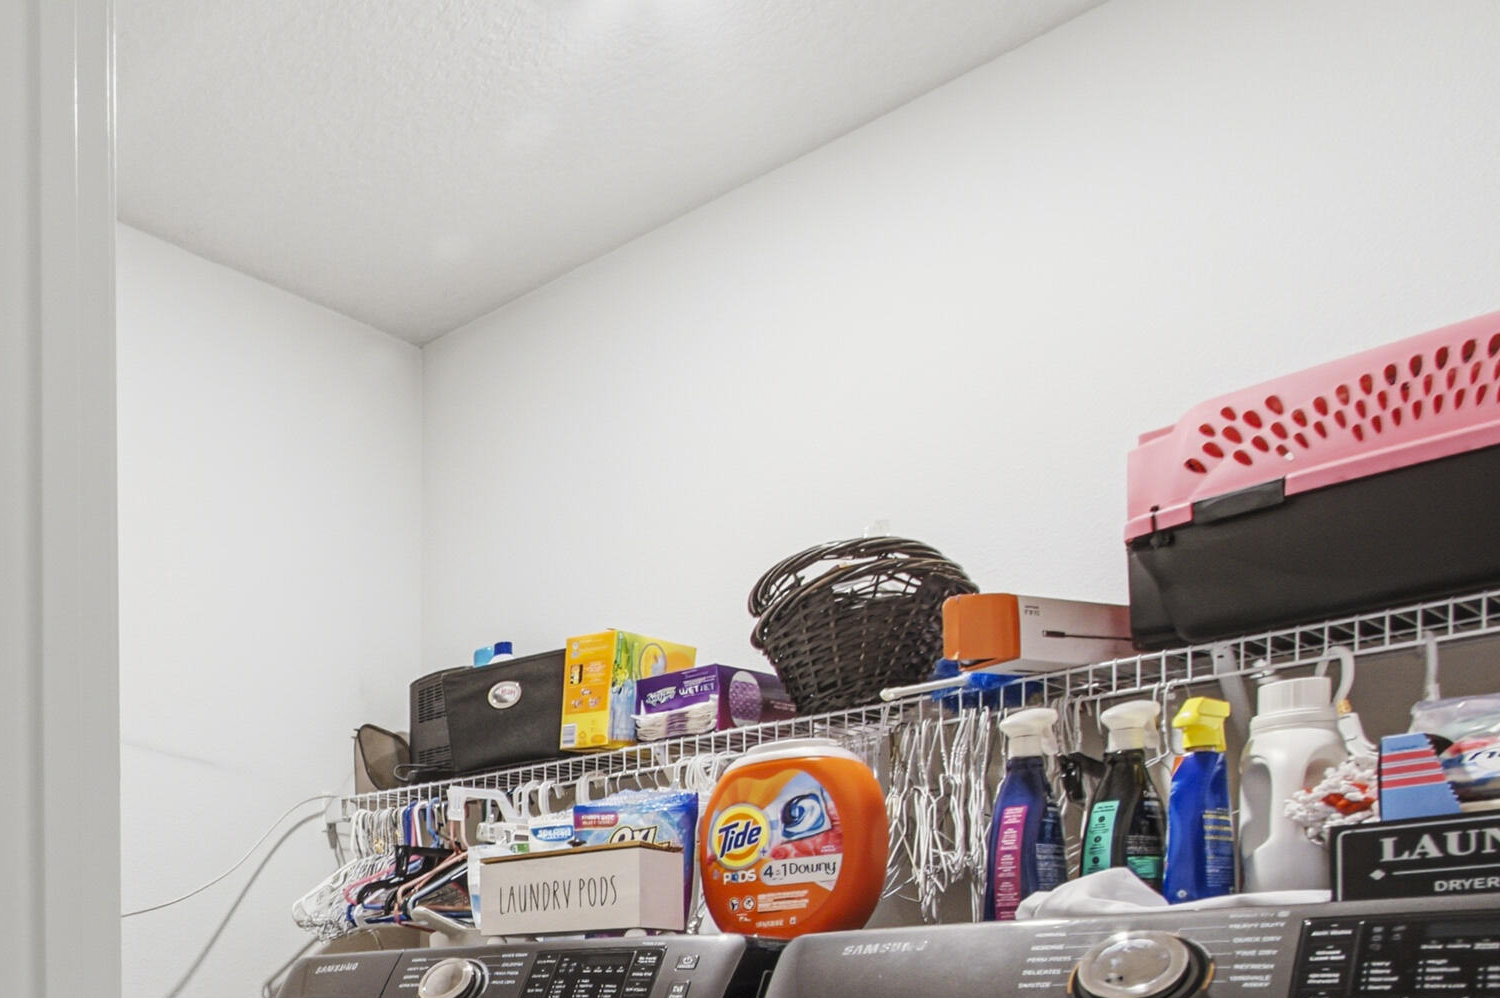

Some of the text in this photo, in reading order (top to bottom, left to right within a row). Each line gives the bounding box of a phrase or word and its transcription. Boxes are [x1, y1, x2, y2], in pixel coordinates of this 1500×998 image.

[718, 820, 762, 858] Tide
[789, 860, 837, 876] Downy
[499, 874, 618, 915] LAUNDRY PODS
